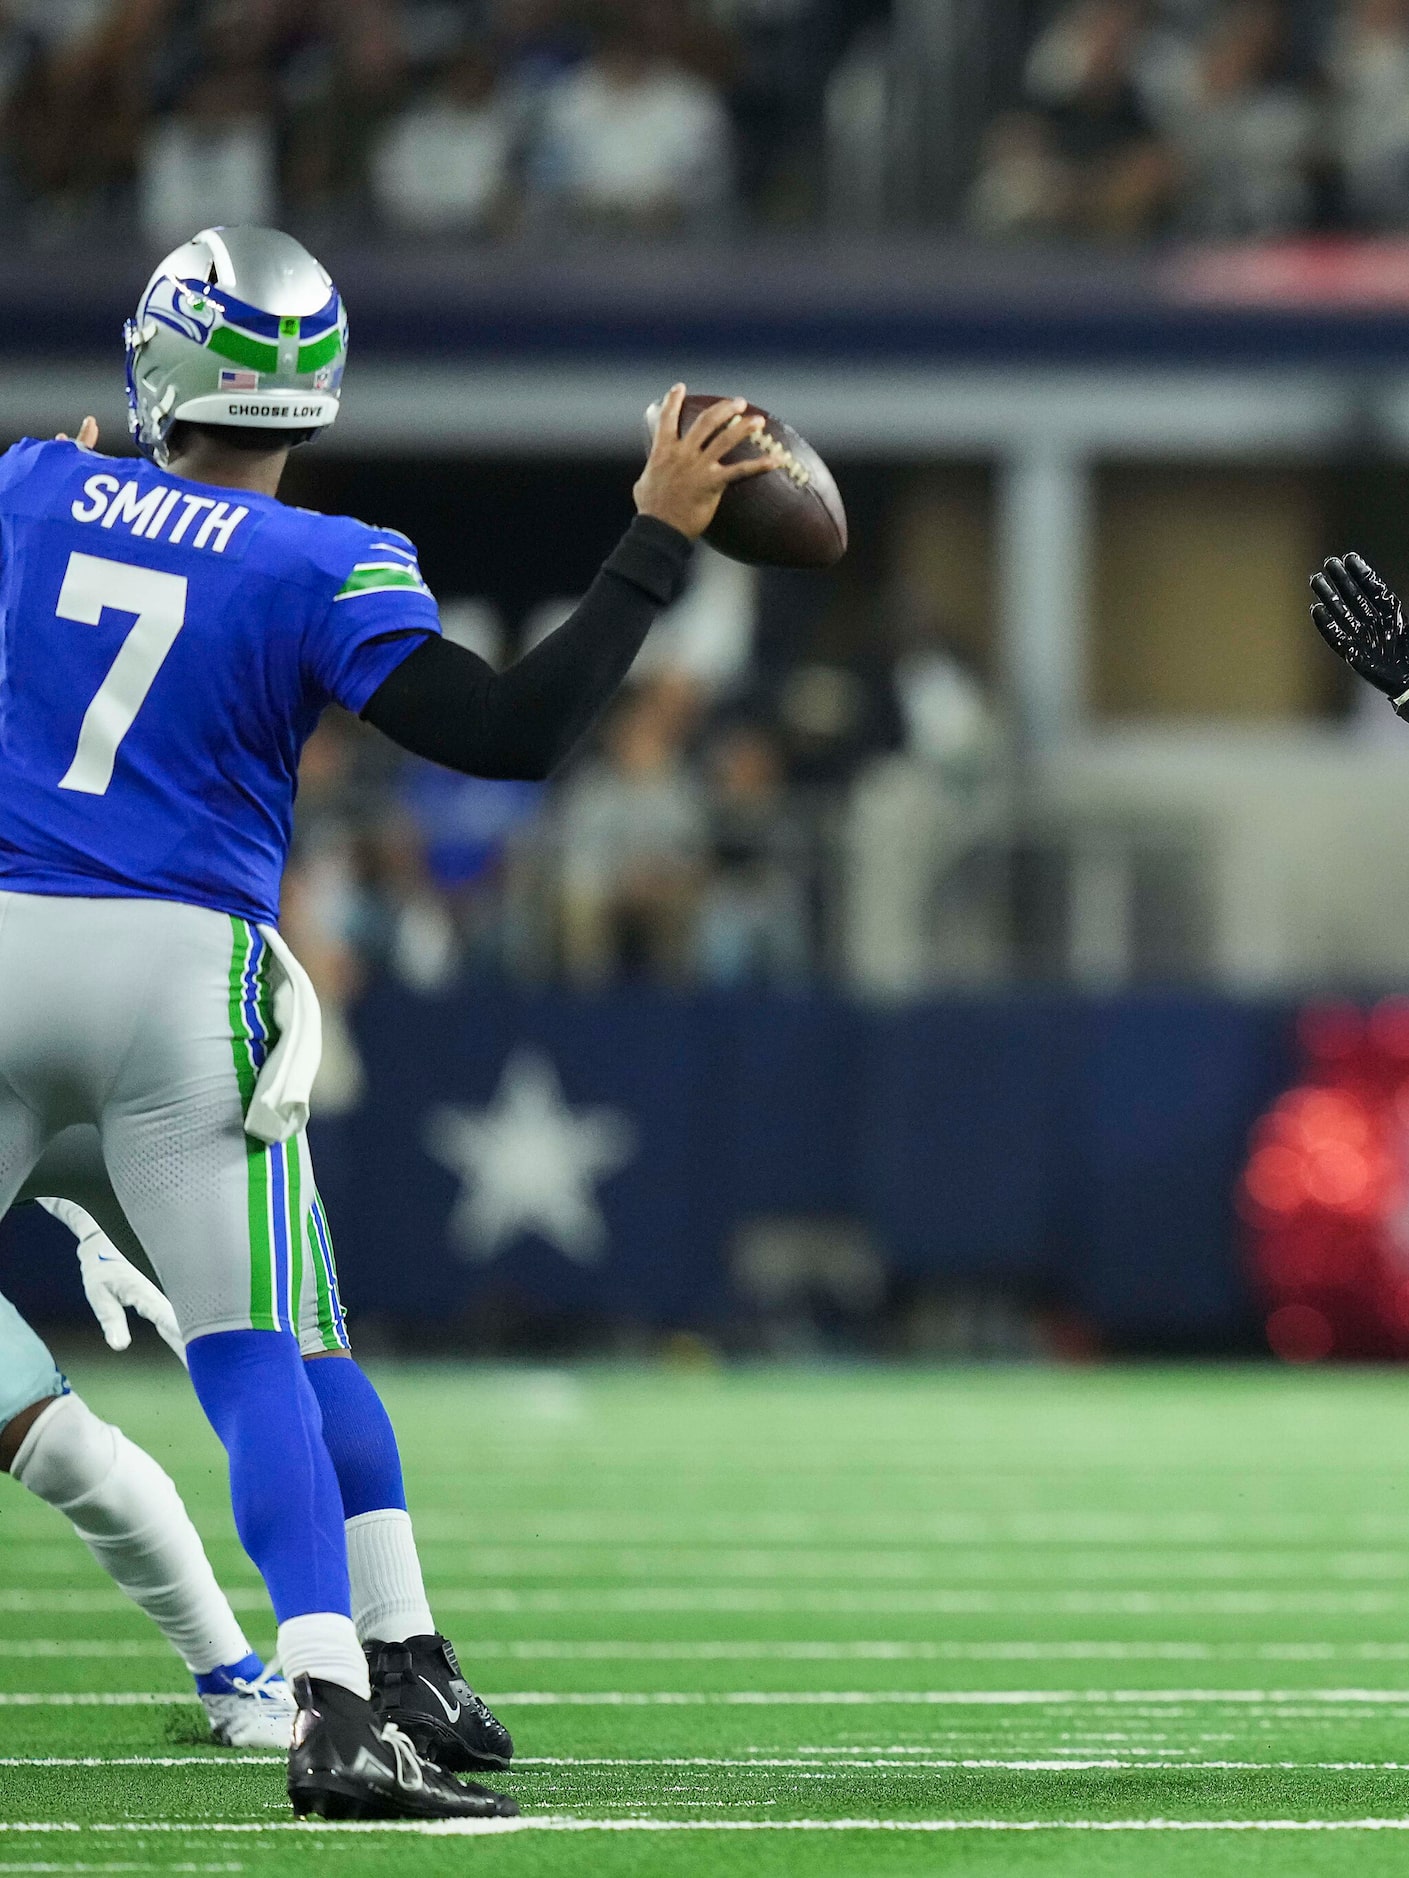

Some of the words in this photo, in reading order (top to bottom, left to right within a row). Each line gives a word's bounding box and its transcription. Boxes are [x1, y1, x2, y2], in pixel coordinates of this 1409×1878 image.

[228, 404, 288, 417] CHOOSE
[293, 406, 323, 417] LOVE
[71, 474, 250, 553] SMITH
[56, 551, 188, 795] 7
